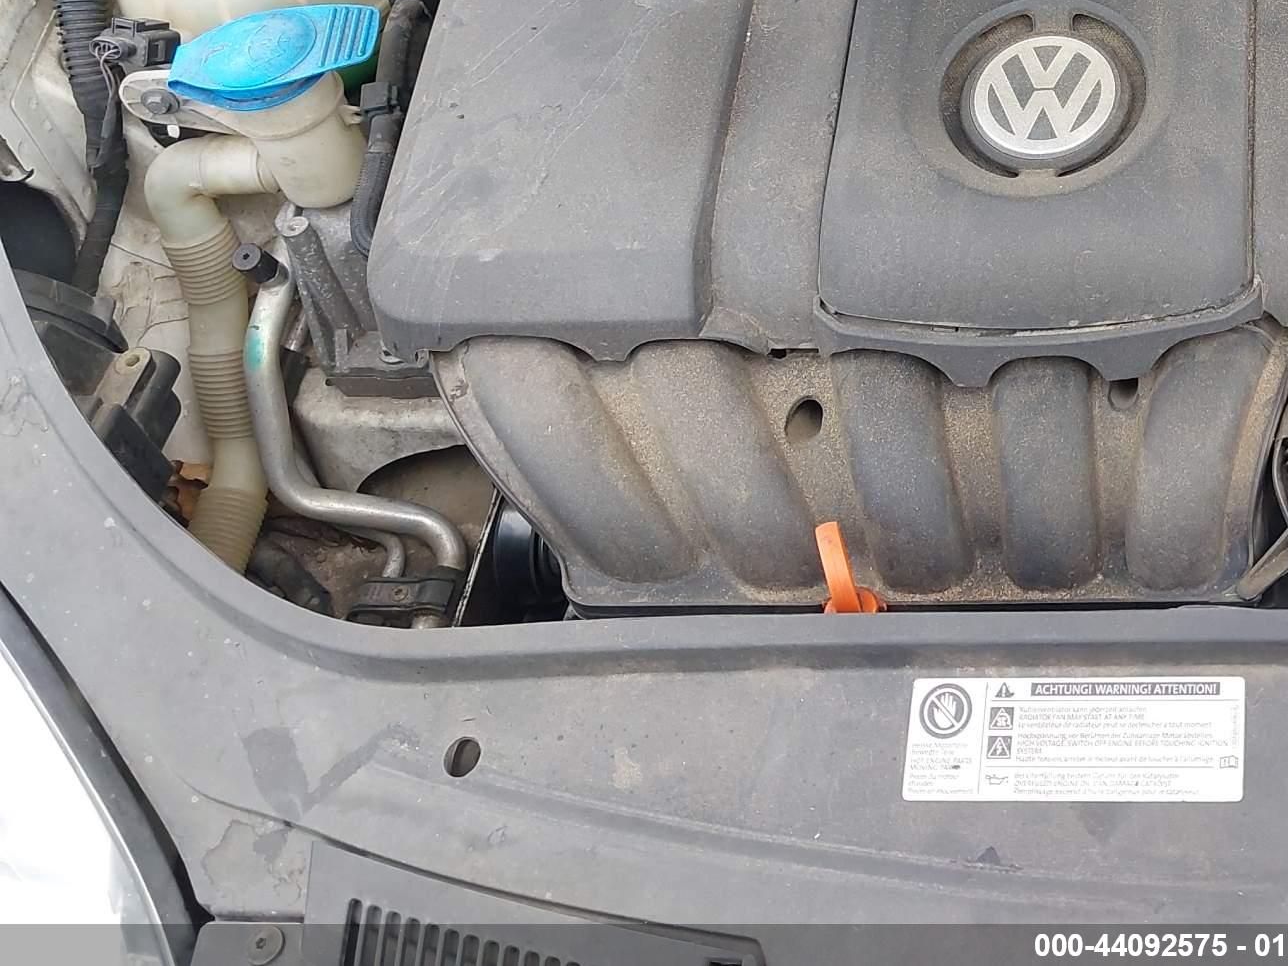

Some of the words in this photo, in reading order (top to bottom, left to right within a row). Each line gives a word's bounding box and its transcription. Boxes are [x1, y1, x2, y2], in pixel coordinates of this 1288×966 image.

[1035, 683, 1092, 695] ACHTUNG!
[1094, 683, 1152, 695] WARNING!
[1153, 683, 1218, 695] ATTENTION!
